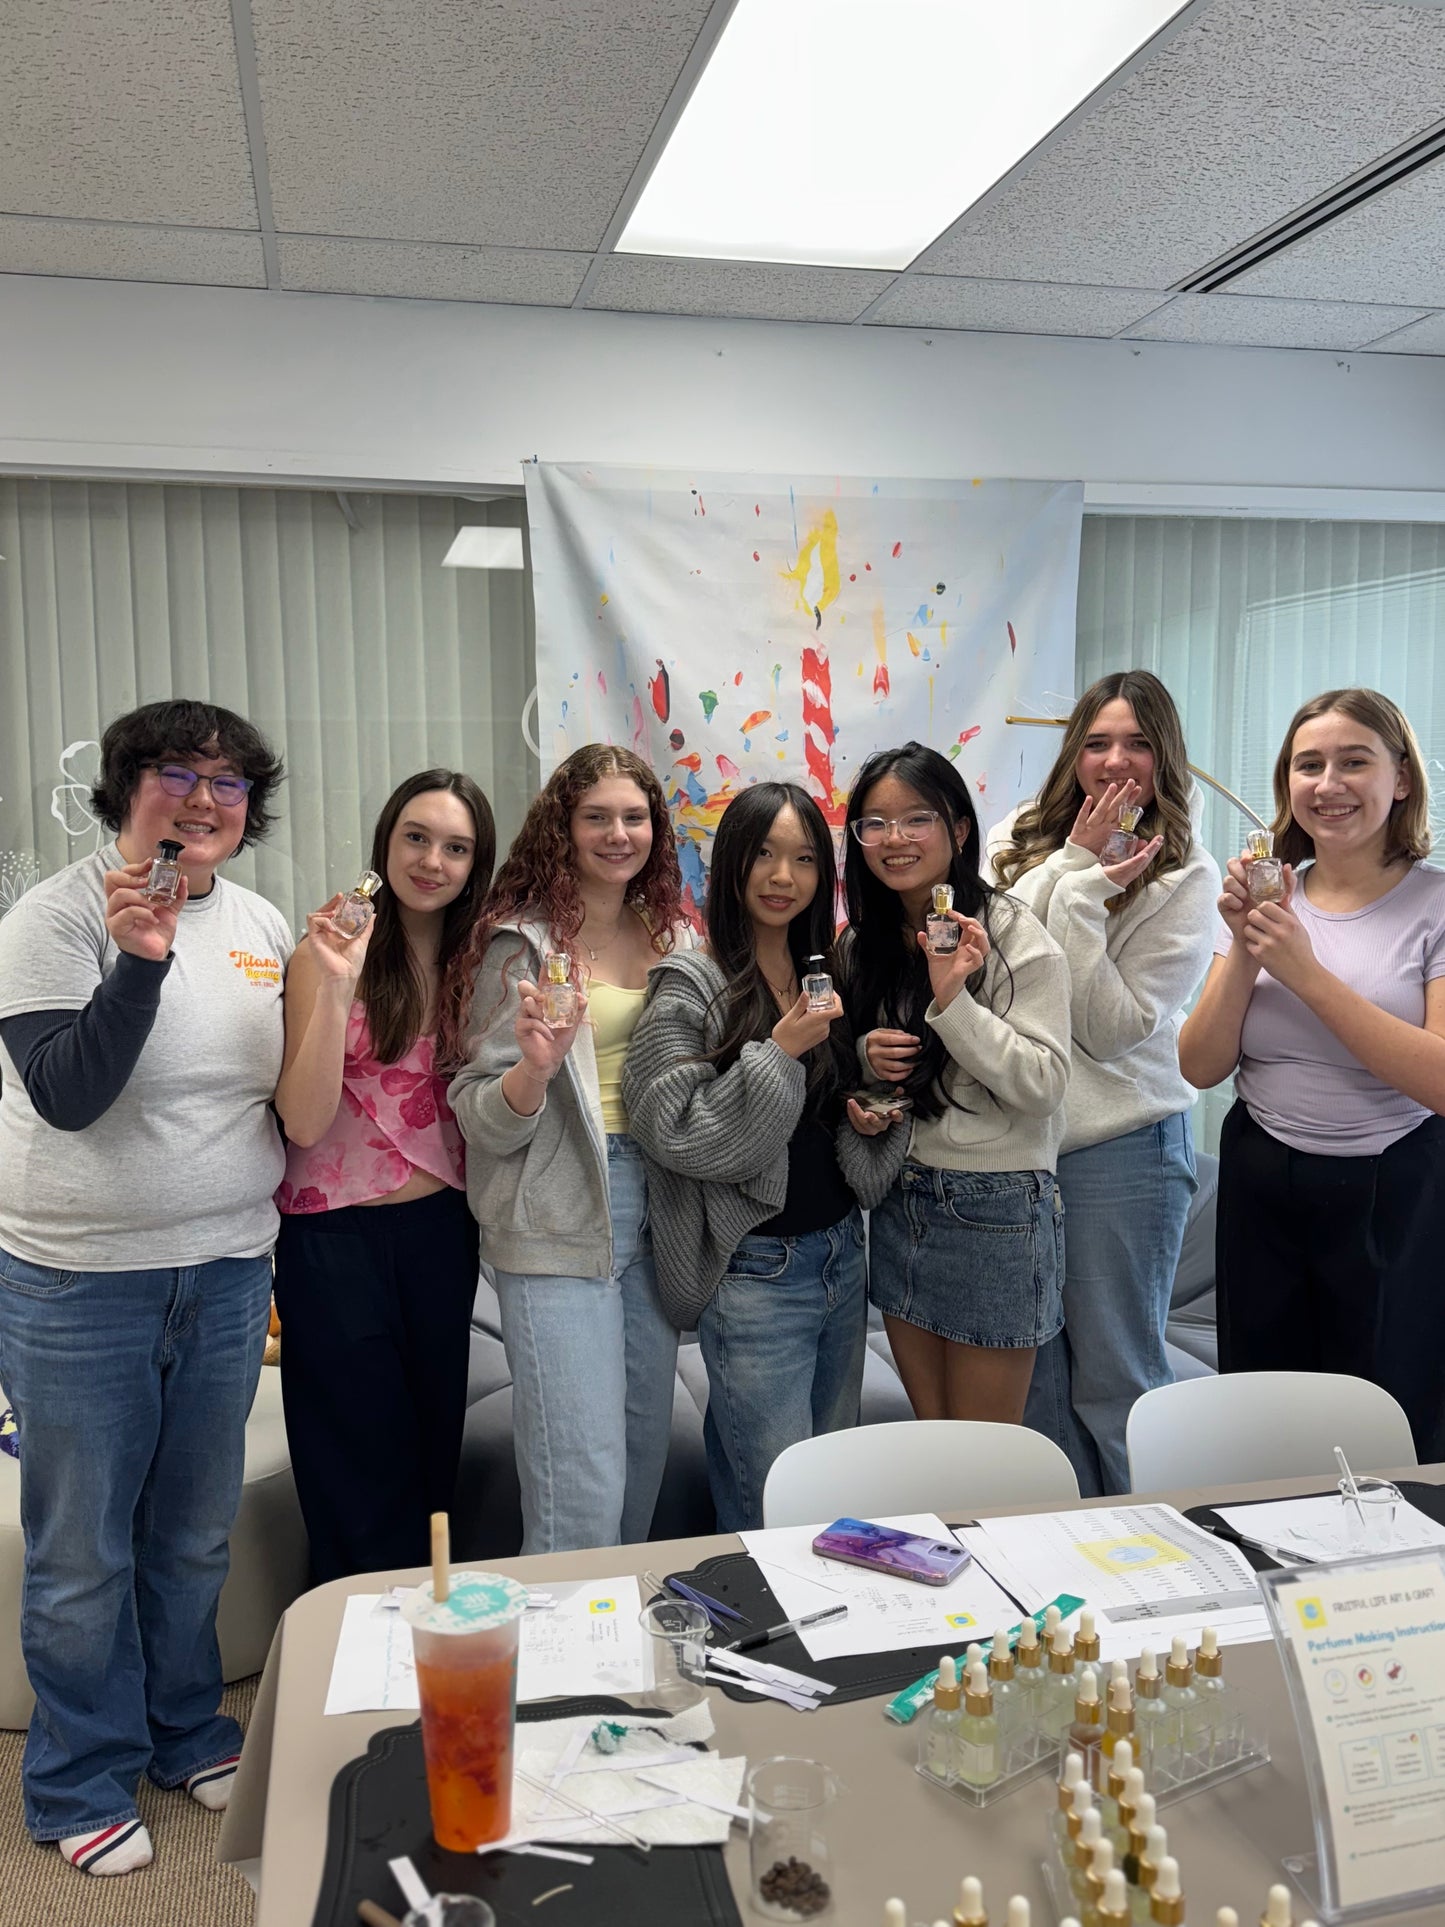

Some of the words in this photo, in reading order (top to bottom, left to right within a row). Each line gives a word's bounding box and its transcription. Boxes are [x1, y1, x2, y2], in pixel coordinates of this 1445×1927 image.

[229, 951, 280, 969] Titans
[1389, 1592, 1404, 1604] ART
[1404, 1591, 1412, 1602] &
[1307, 1636, 1354, 1652] Perfume
[1354, 1629, 1396, 1643] Making
